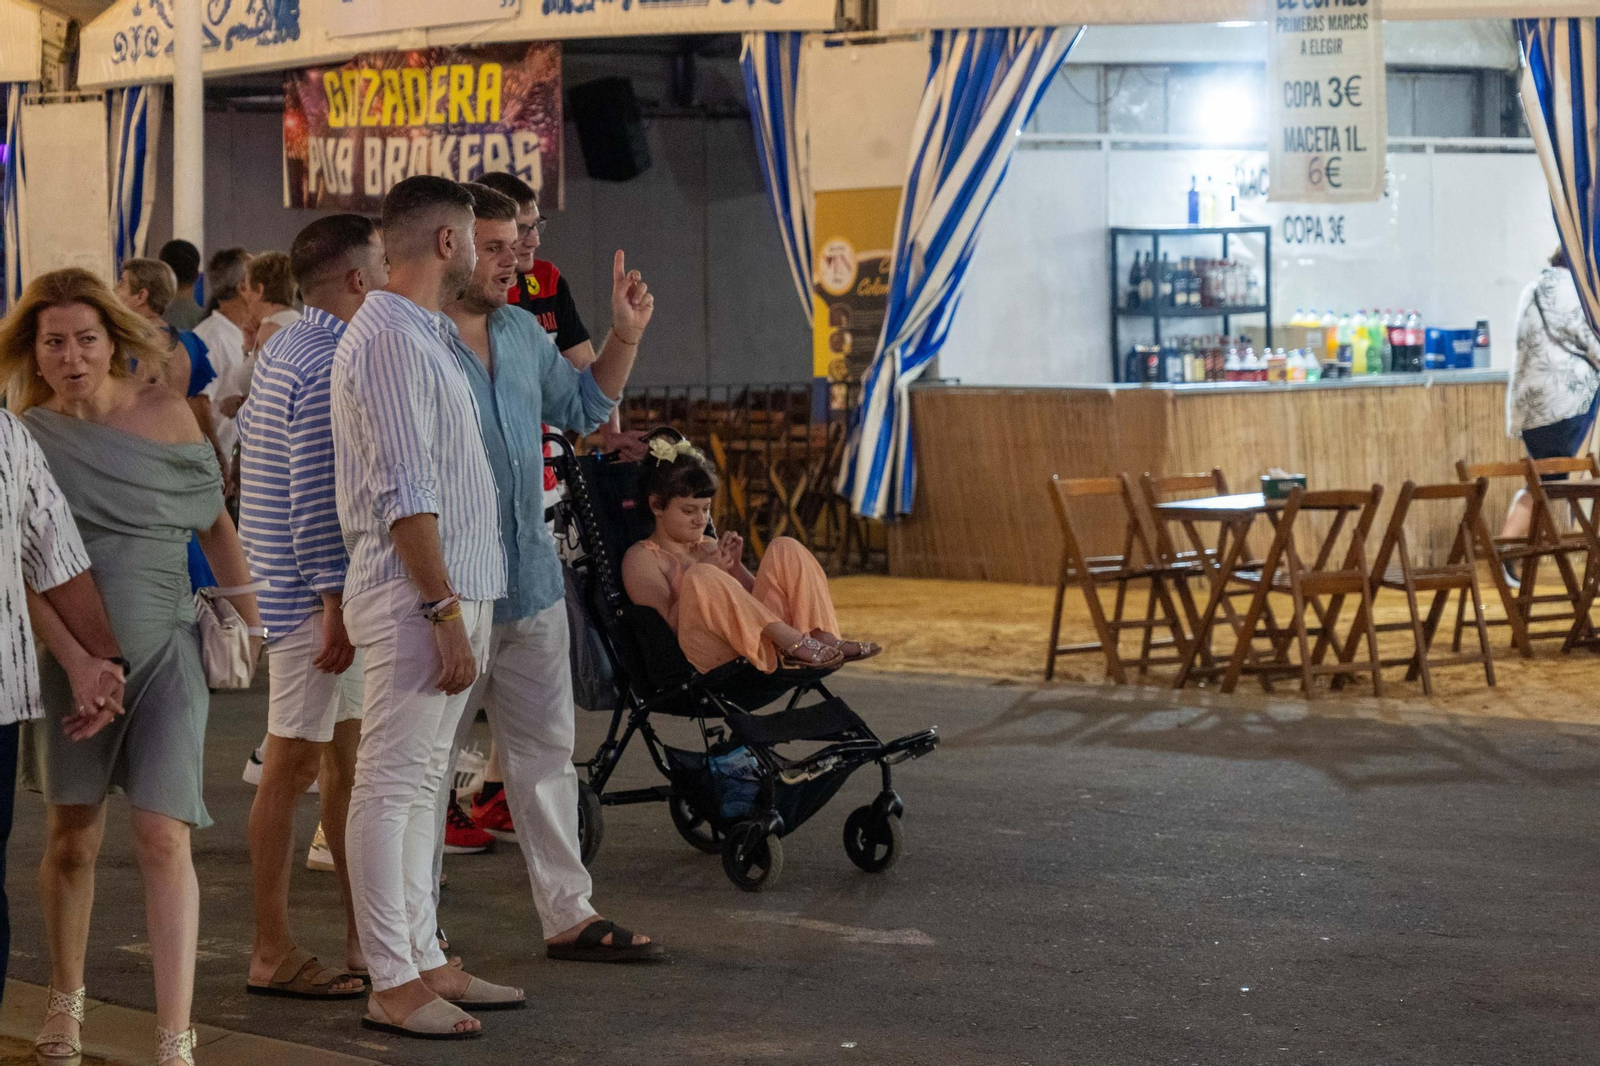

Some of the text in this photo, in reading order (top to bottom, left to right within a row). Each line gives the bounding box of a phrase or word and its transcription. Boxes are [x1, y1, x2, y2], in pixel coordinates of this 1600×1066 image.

[1276, 13, 1369, 33] PRIMERAS MARCAS
[1301, 37, 1343, 56] A ELEGIR
[323, 63, 503, 128] GOZADERA
[1283, 75, 1362, 108] COPA 3€
[1283, 126, 1341, 153] MACETA
[308, 136, 355, 195] PUB
[1308, 156, 1342, 188] 6€
[1283, 216, 1346, 244] COPA 3€
